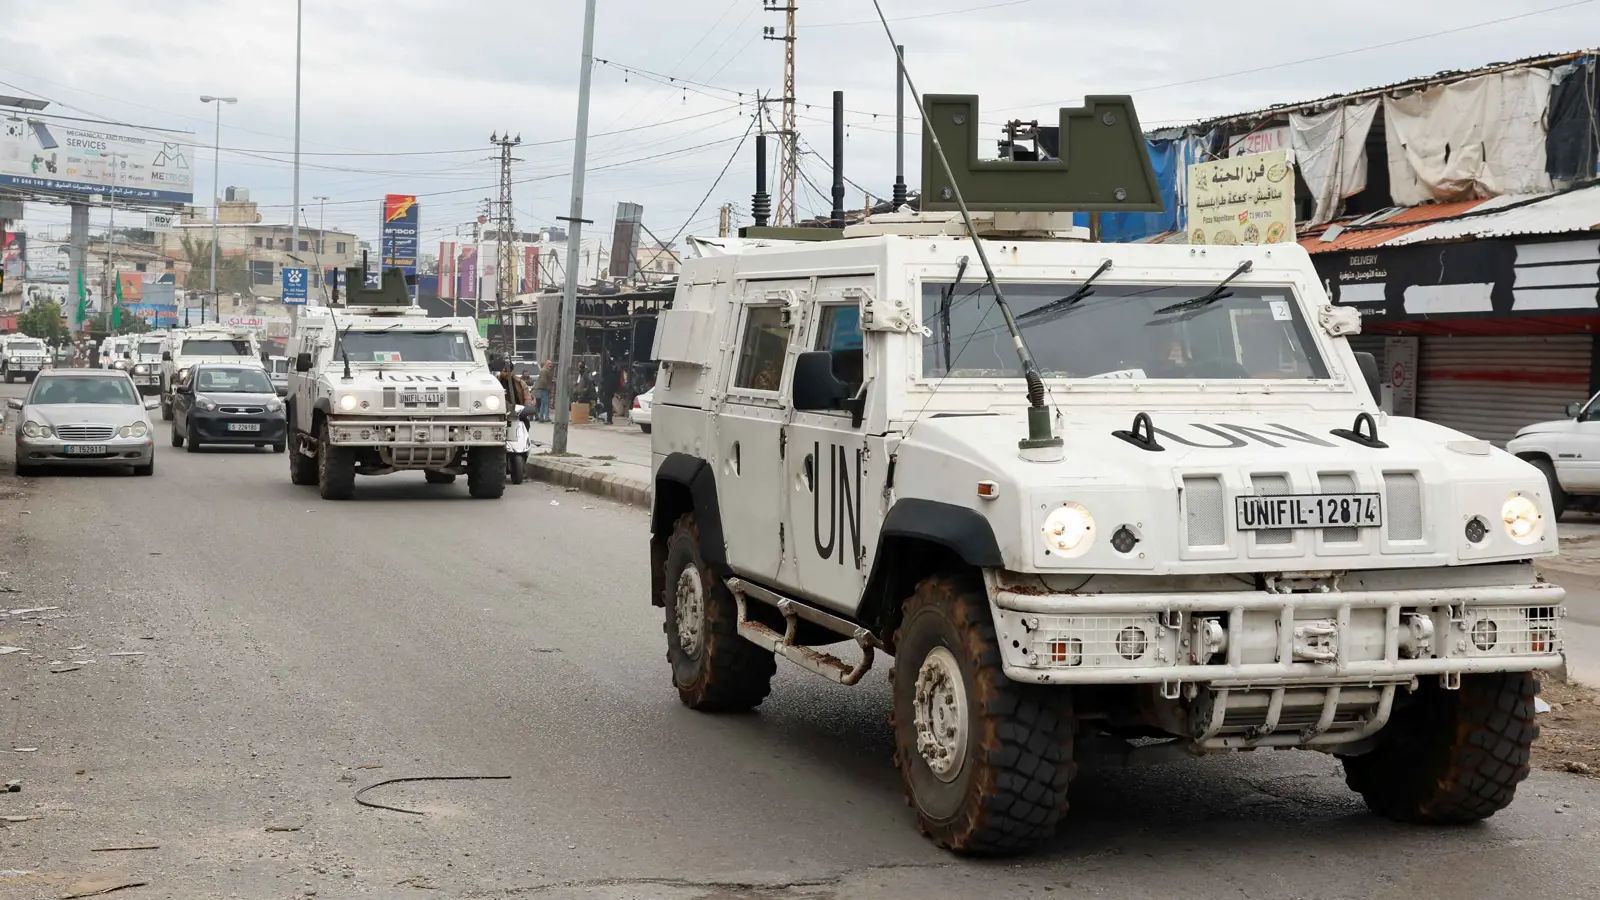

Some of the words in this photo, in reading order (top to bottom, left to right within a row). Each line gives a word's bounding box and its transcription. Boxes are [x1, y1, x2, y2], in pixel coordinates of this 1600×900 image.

[67, 130, 105, 139] MECHANICAL
[66, 138, 106, 150] SERVICES
[1248, 133, 1272, 153] ZEIN
[152, 171, 190, 182] METRICS
[1246, 158, 1265, 183] فرن
[1228, 190, 1247, 204] كعكة
[1254, 188, 1282, 204] مناقيش
[1350, 255, 1378, 266] DELIVERY
[1277, 306, 1286, 316] 2
[1140, 423, 1340, 448] UN
[814, 441, 862, 570] UN
[1243, 498, 1376, 526] UNIFIL-12874
